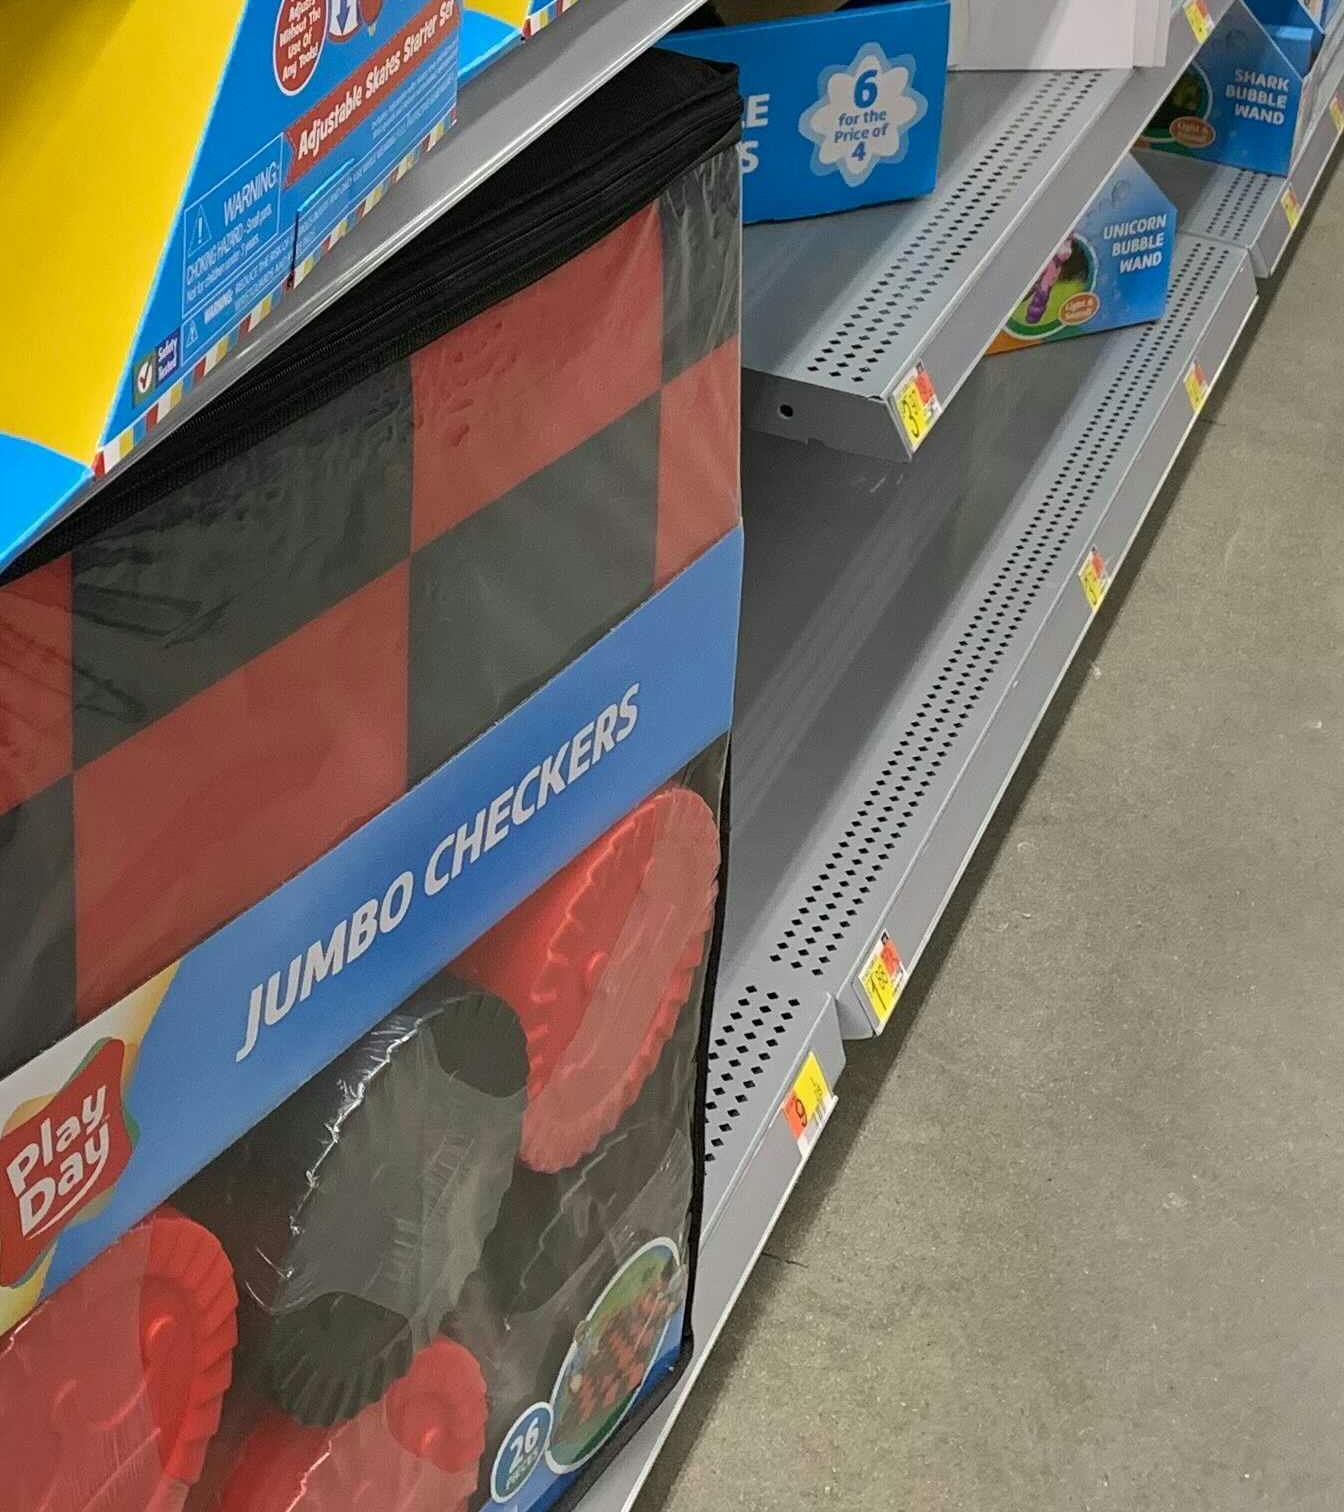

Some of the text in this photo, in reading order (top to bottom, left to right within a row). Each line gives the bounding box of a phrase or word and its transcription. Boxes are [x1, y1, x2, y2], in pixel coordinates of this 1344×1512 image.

[280, 7, 321, 47] Without The
[283, 43, 319, 82] Any Tools!
[297, 84, 362, 160] Adjustable
[365, 50, 401, 99] Skates
[403, 17, 437, 63] Starter
[854, 69, 878, 109] 6
[1234, 68, 1290, 91] SHARK
[1226, 85, 1288, 109] BUBBLE
[839, 109, 886, 127] for the
[1234, 103, 1285, 125] WAND
[834, 123, 889, 144] Price of
[852, 142, 866, 162] 4
[1104, 213, 1167, 240] UNICORN
[1112, 232, 1164, 257] BUBBLE
[1120, 251, 1162, 274] WAND
[158, 337, 178, 363] Safety
[235, 683, 640, 1062] JUMBO CHECKERS
[7, 1085, 107, 1197] Play
[17, 1122, 111, 1239] Day
[509, 1417, 539, 1474] 26
